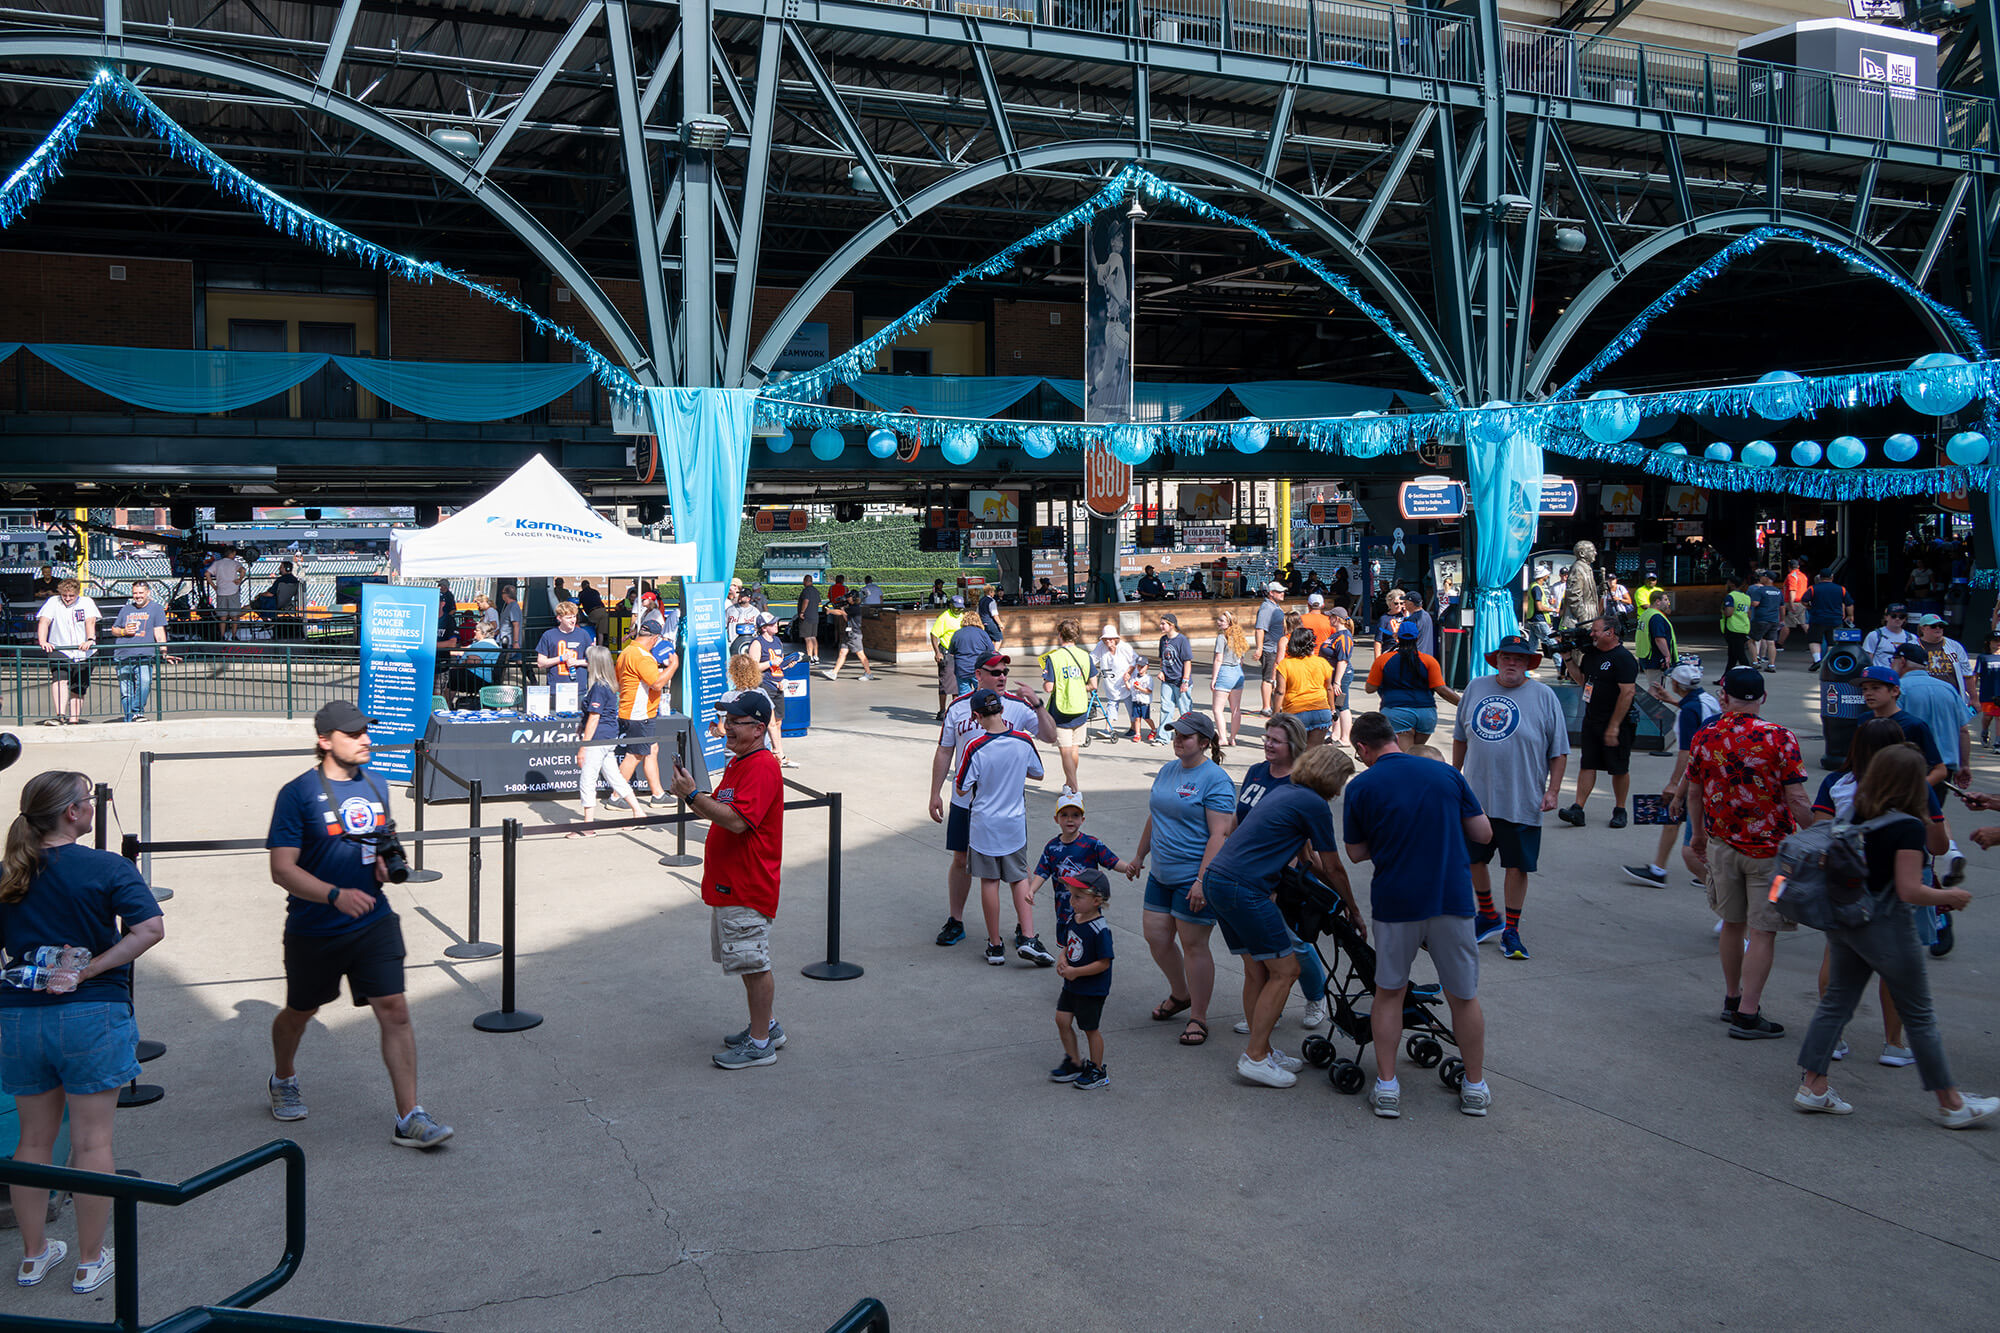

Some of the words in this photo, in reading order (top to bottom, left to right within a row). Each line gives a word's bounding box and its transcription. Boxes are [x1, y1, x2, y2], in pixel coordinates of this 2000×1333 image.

[1892, 63, 1911, 77] NEW
[1425, 444, 1444, 457] 117
[1438, 455, 1449, 467] EXIT
[1090, 451, 1124, 497] 1980
[516, 519, 603, 539] Karmanos
[1188, 529, 1203, 537] COLD
[1205, 529, 1220, 537] BEER
[546, 533, 593, 543] INSTITUTE
[976, 531, 993, 540] COLD
[994, 531, 1012, 540] BEER
[1128, 557, 1136, 565] 11
[1161, 556, 1171, 565] 42
[373, 608, 411, 618] PROSTATE
[372, 617, 404, 627] CANCER
[371, 627, 420, 638] AWARENESS
[1482, 697, 1516, 711] DETROIT
[1476, 728, 1506, 739] TIGERS
[529, 756, 572, 767] CANCER
[504, 780, 578, 792] 1-800-KARMANOS
